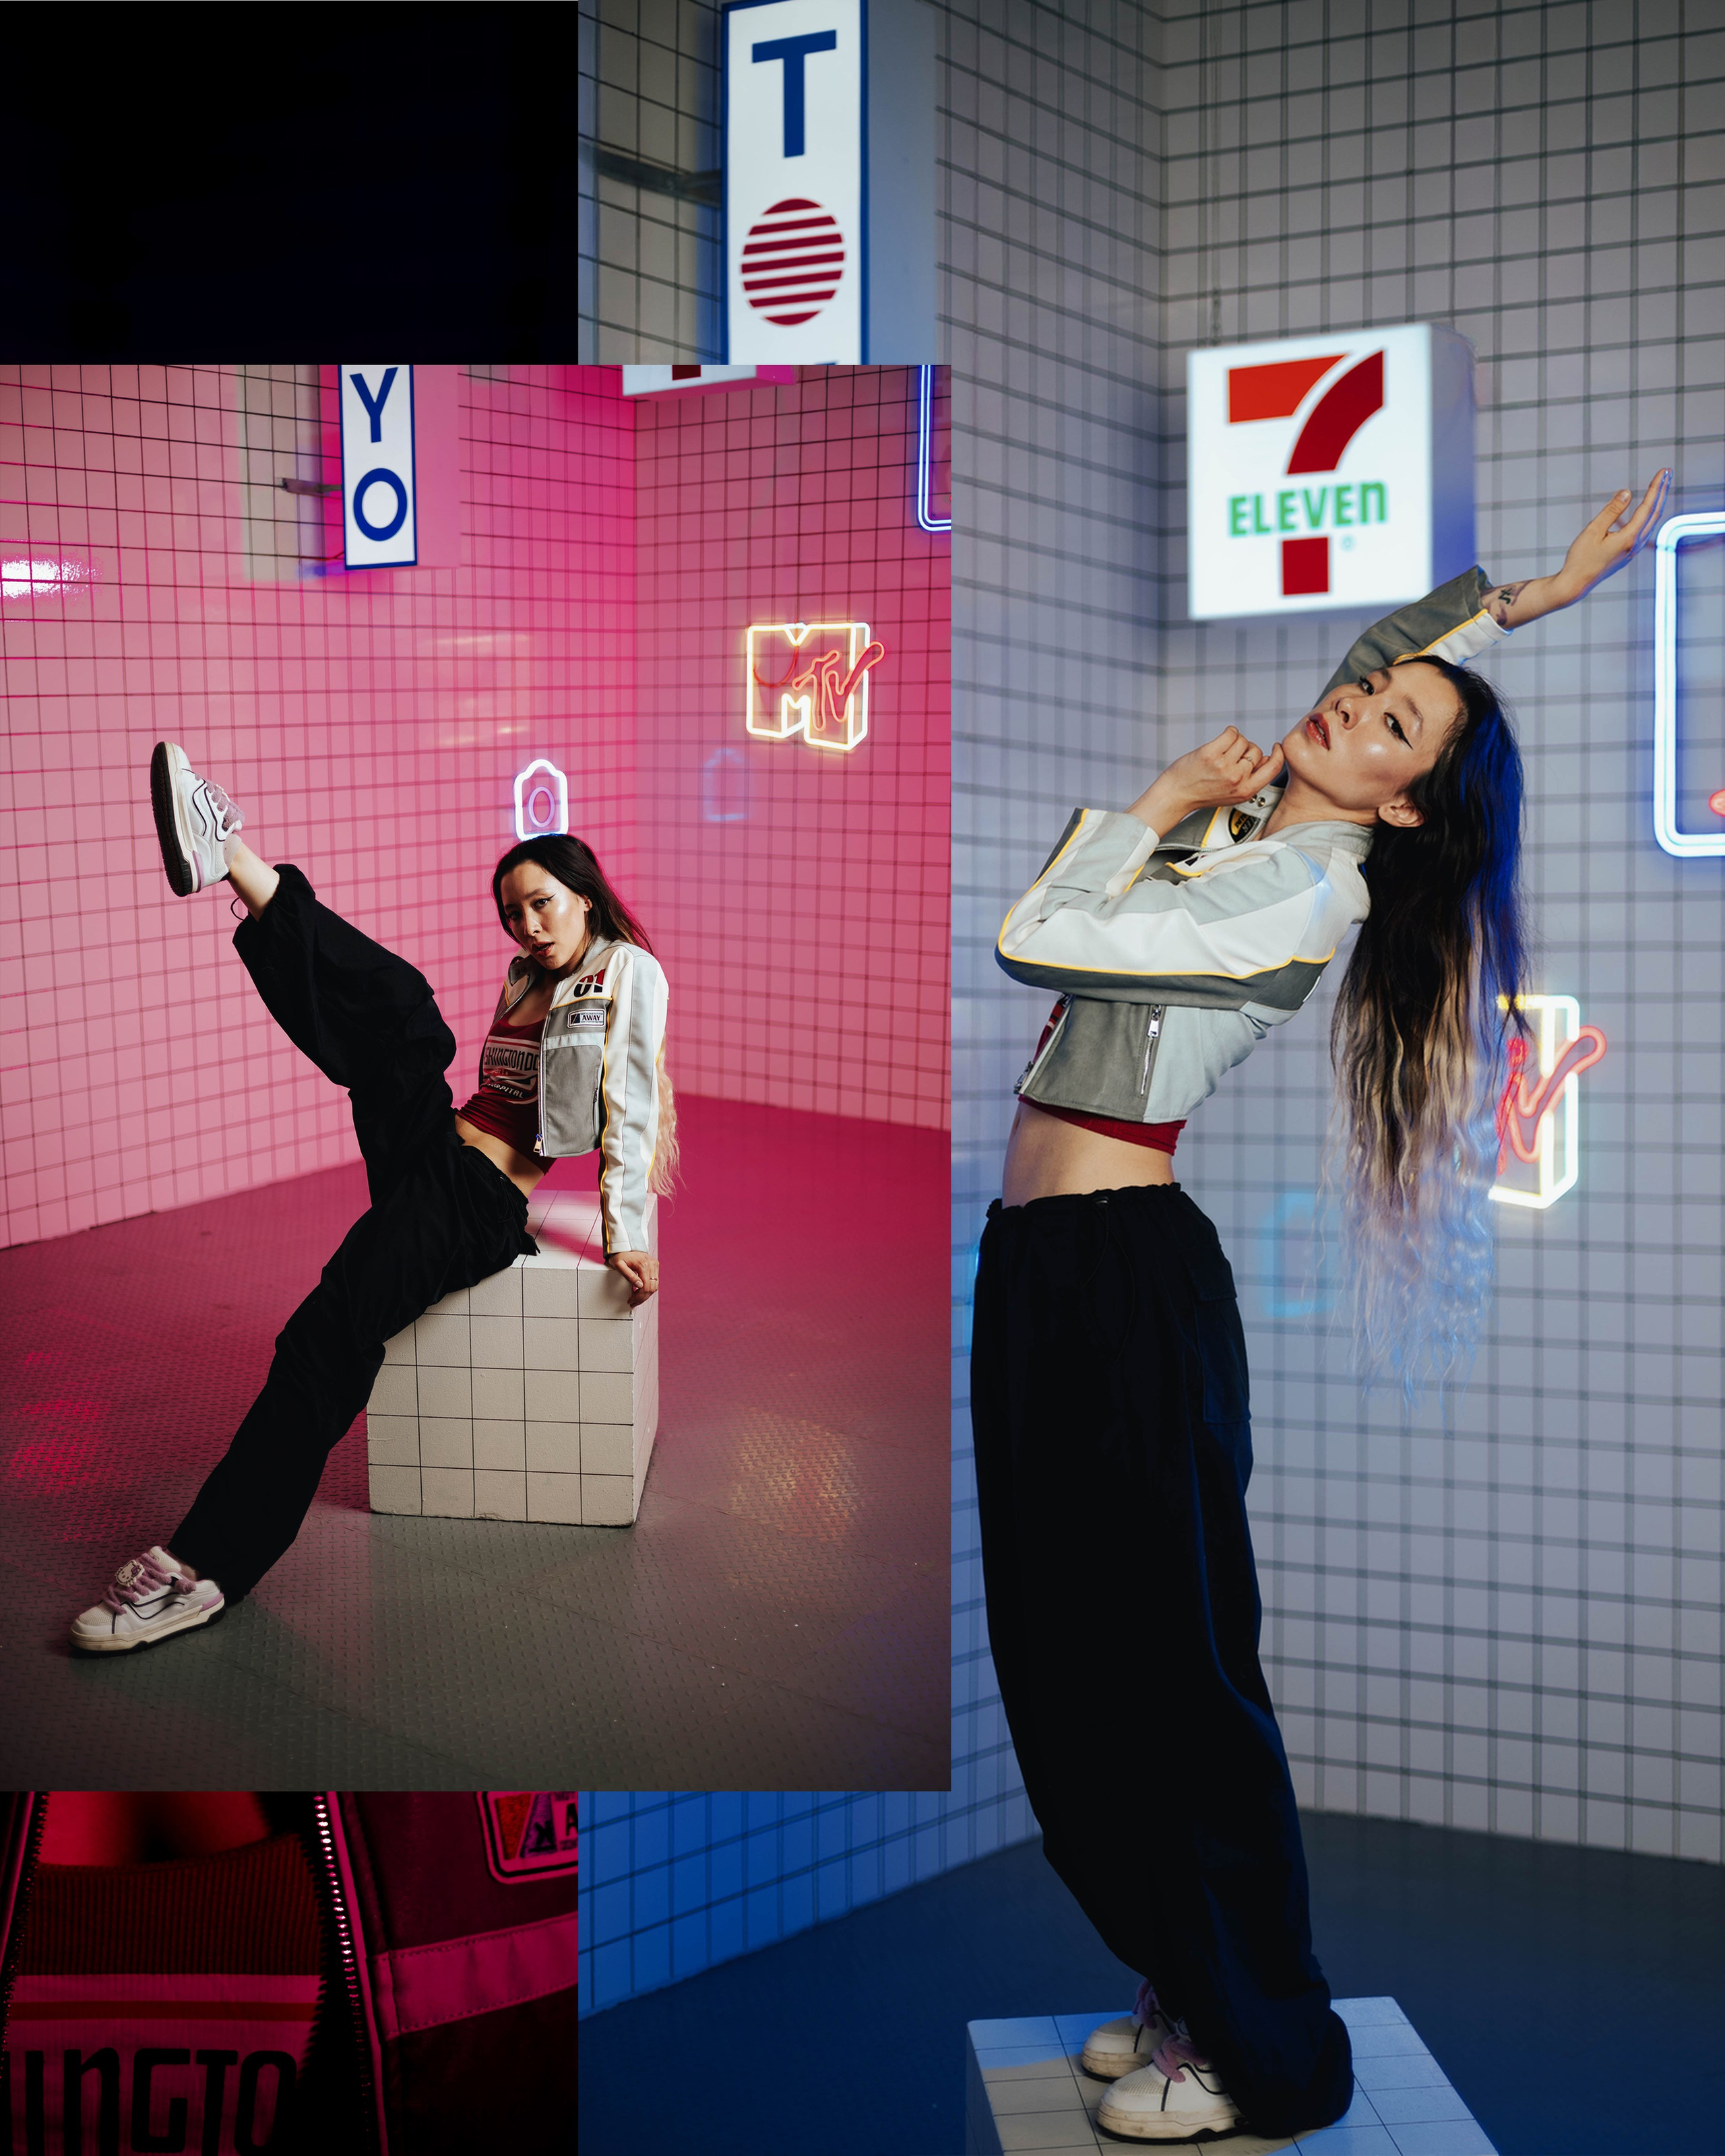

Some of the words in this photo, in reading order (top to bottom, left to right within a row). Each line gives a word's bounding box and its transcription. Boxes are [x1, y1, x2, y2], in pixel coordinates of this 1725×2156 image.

[1228, 349, 1385, 596] 7
[747, 623, 885, 751] MTV
[573, 968, 606, 998] 01
